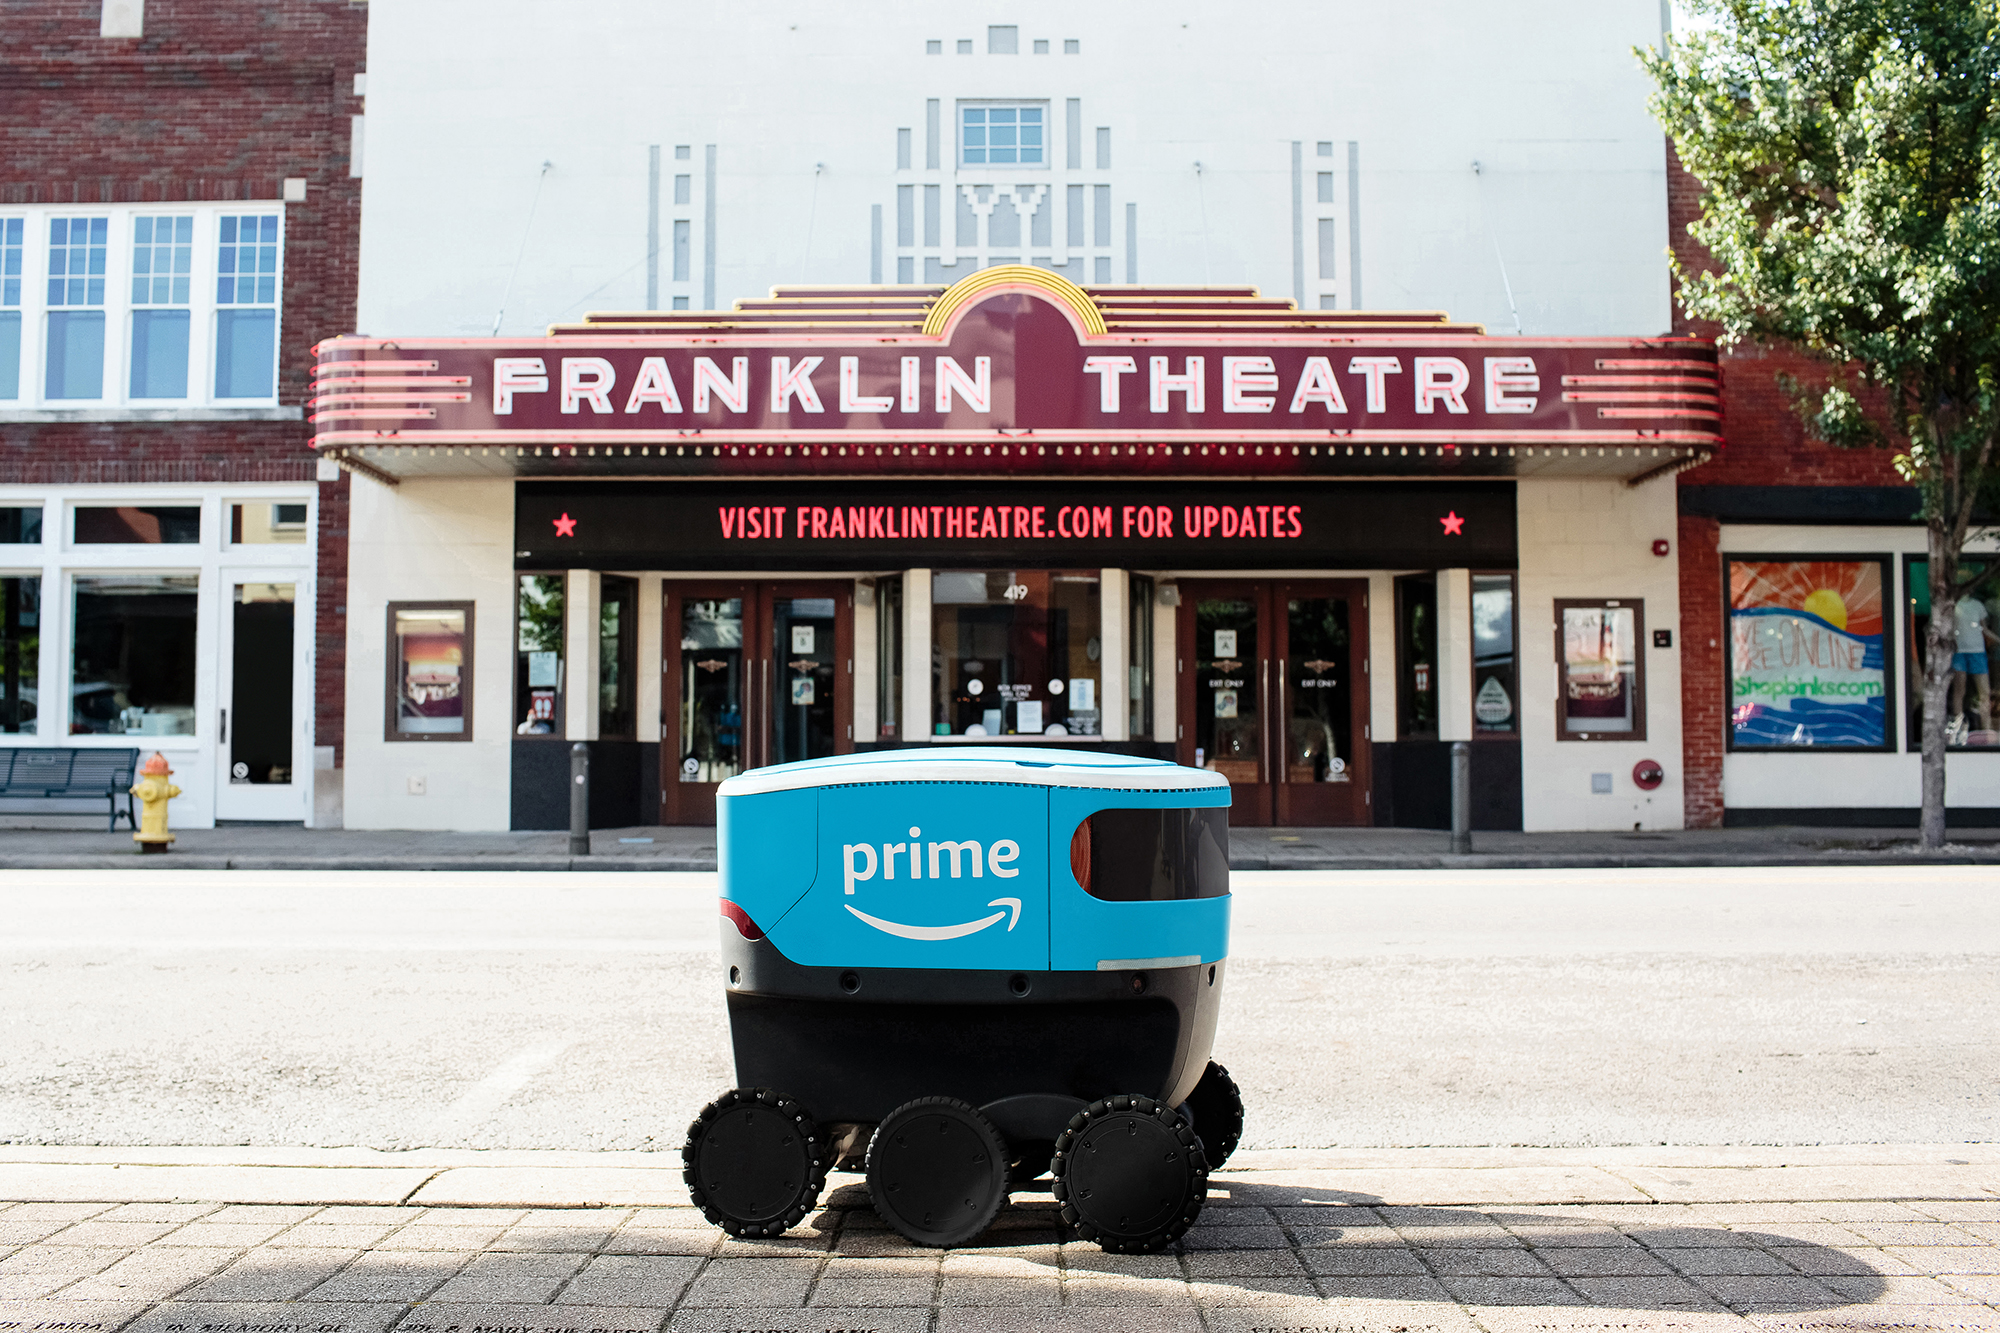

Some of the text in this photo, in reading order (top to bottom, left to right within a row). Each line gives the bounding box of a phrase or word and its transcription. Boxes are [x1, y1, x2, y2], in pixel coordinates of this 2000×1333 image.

[493, 356, 1540, 415] FRANKLIN THEATRE
[719, 506, 1303, 539] VISIT FRANKLINTHEATRE.COM FOR UPDATES
[1003, 584, 1029, 600] 419
[1778, 618, 1867, 671] ONLINE
[1224, 679, 1244, 688] ONLY
[1317, 679, 1337, 688] ONLY
[843, 826, 1020, 895] prime
